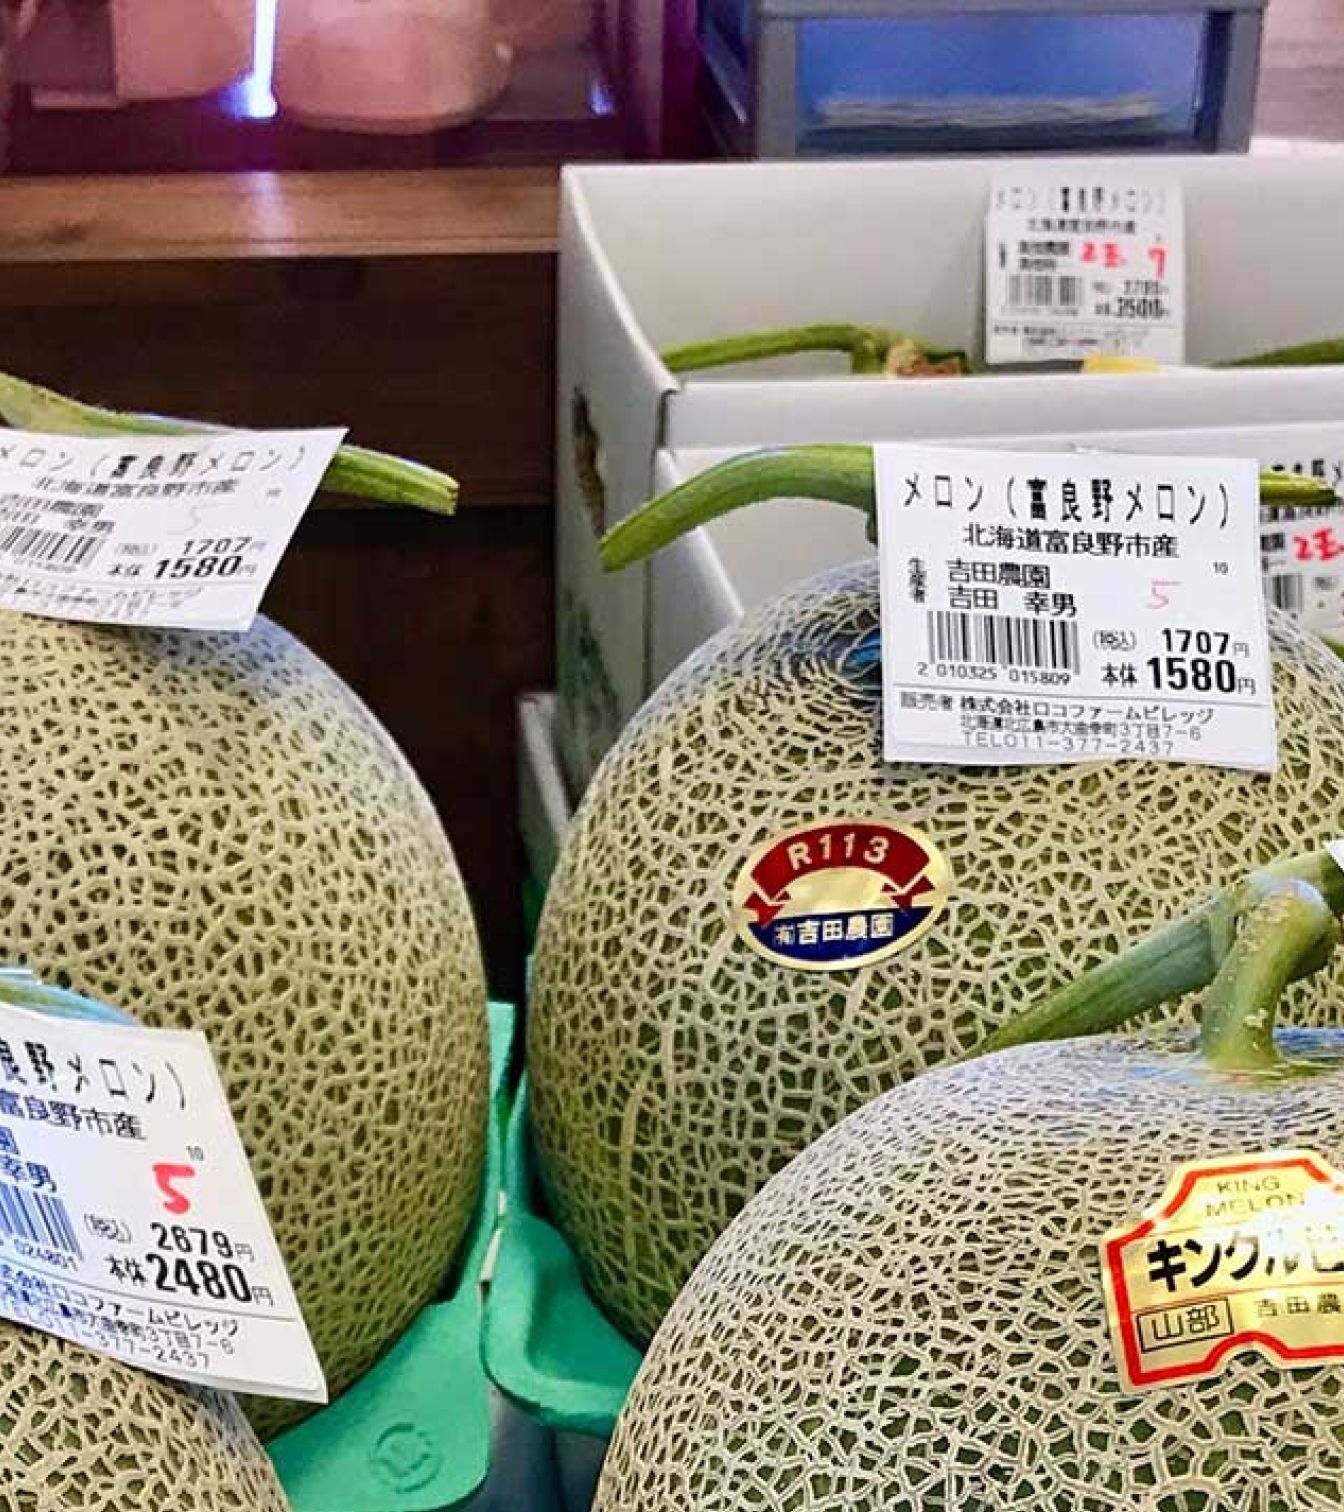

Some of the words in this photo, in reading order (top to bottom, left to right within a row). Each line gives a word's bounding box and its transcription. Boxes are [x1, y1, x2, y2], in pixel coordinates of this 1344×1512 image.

[963, 523, 1181, 558] 北海道富良野市産
[947, 558, 1051, 590] 吉田農園
[936, 663, 998, 681] 010325
[1009, 667, 1072, 687] 015809
[1101, 662, 1139, 688] 本体
[1146, 656, 1257, 696] 1580円
[787, 832, 890, 870] R113
[151, 1161, 196, 1215] 5
[1216, 1175, 1281, 1194] KING
[145, 1252, 275, 1309] 2480円
[1151, 1308, 1221, 1340] 山部
